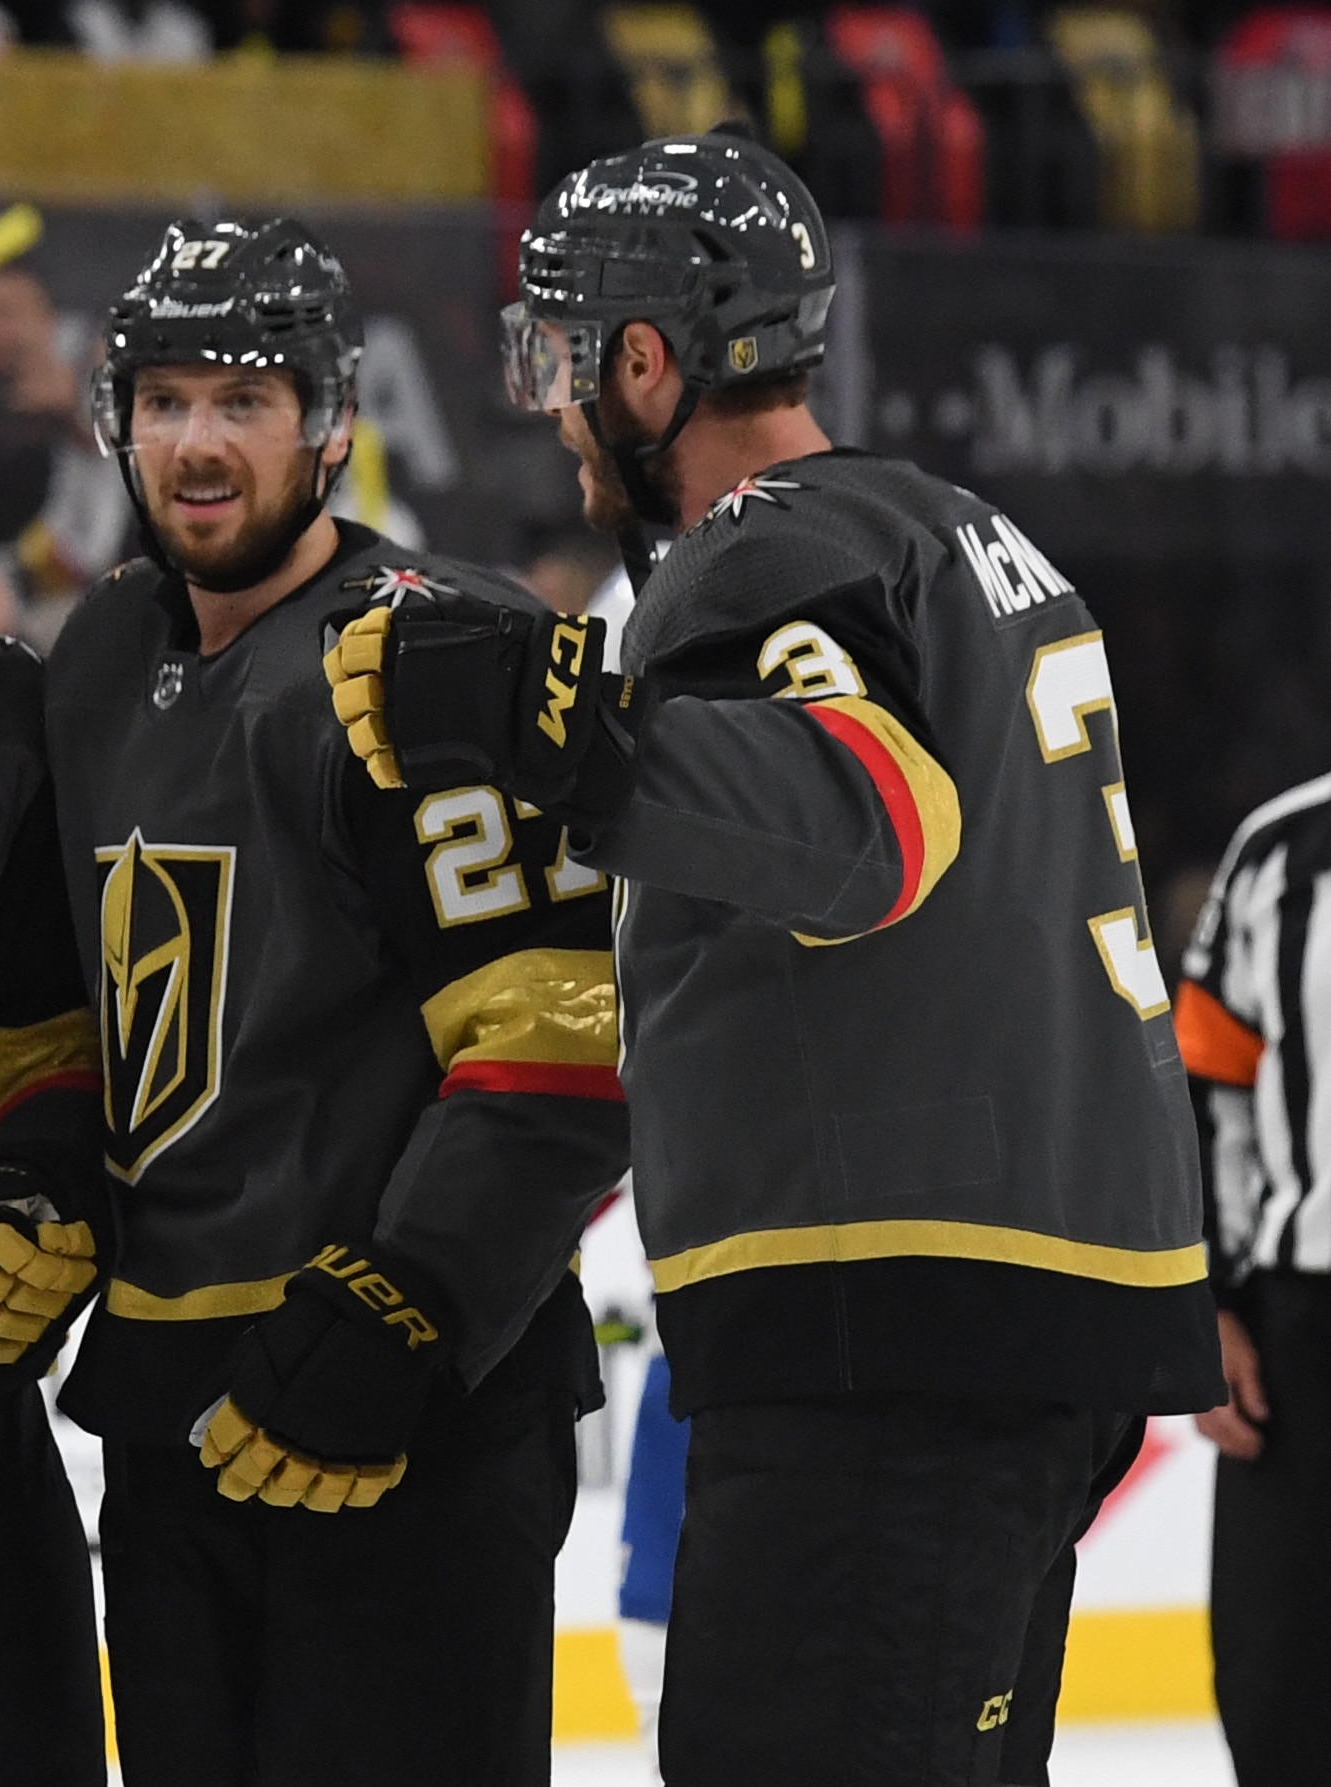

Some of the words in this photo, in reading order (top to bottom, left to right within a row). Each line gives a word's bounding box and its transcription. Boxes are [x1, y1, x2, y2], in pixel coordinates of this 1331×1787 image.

[172, 240, 229, 270] 27
[791, 222, 816, 271] 3
[537, 611, 589, 749] CM
